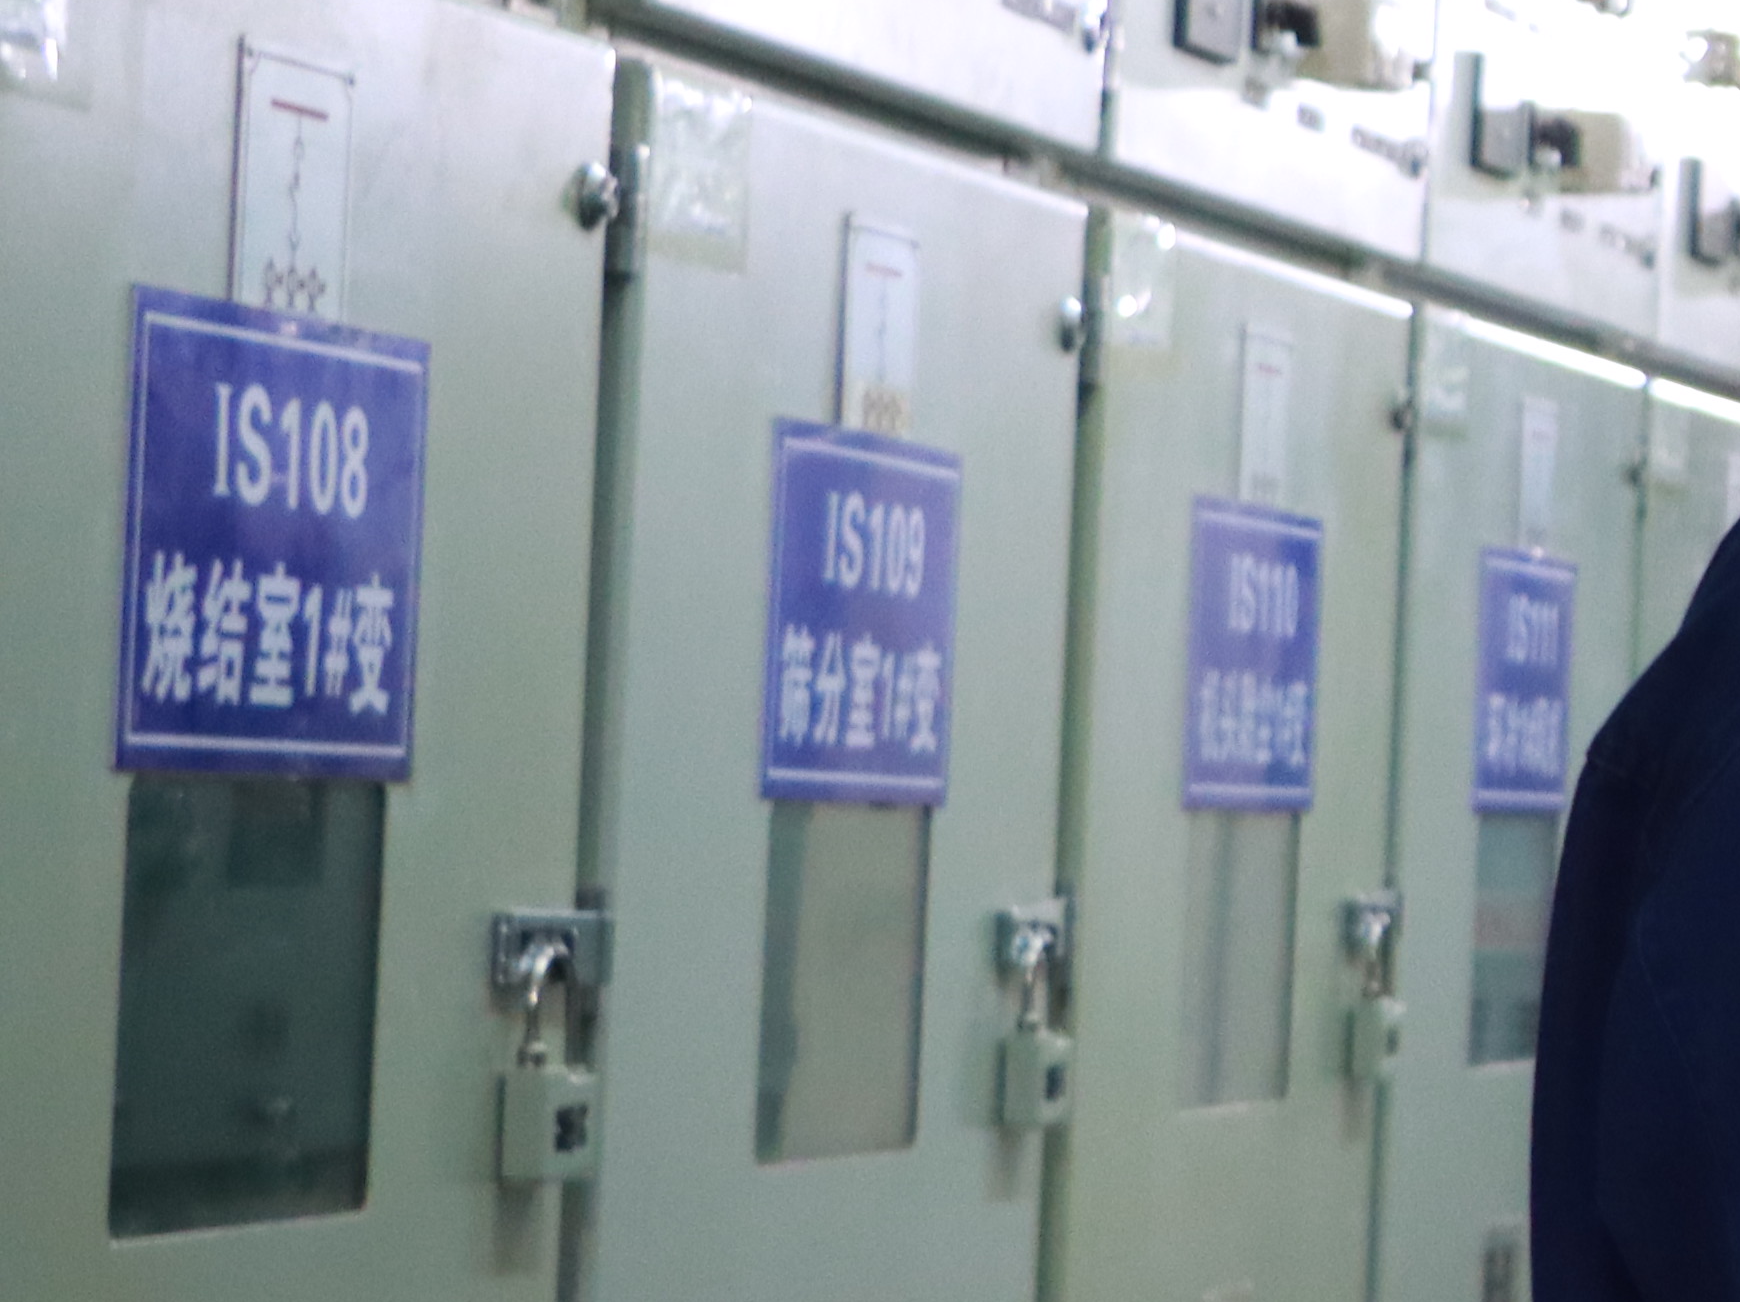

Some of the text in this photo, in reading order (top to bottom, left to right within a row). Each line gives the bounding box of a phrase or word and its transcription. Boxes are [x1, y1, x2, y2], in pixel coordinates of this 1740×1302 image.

[213, 381, 370, 518] IS108
[822, 492, 926, 599] IS109
[1228, 552, 1299, 638] IS110
[141, 550, 395, 715] 烧结室1#变
[780, 623, 942, 753] 筛分室1#变
